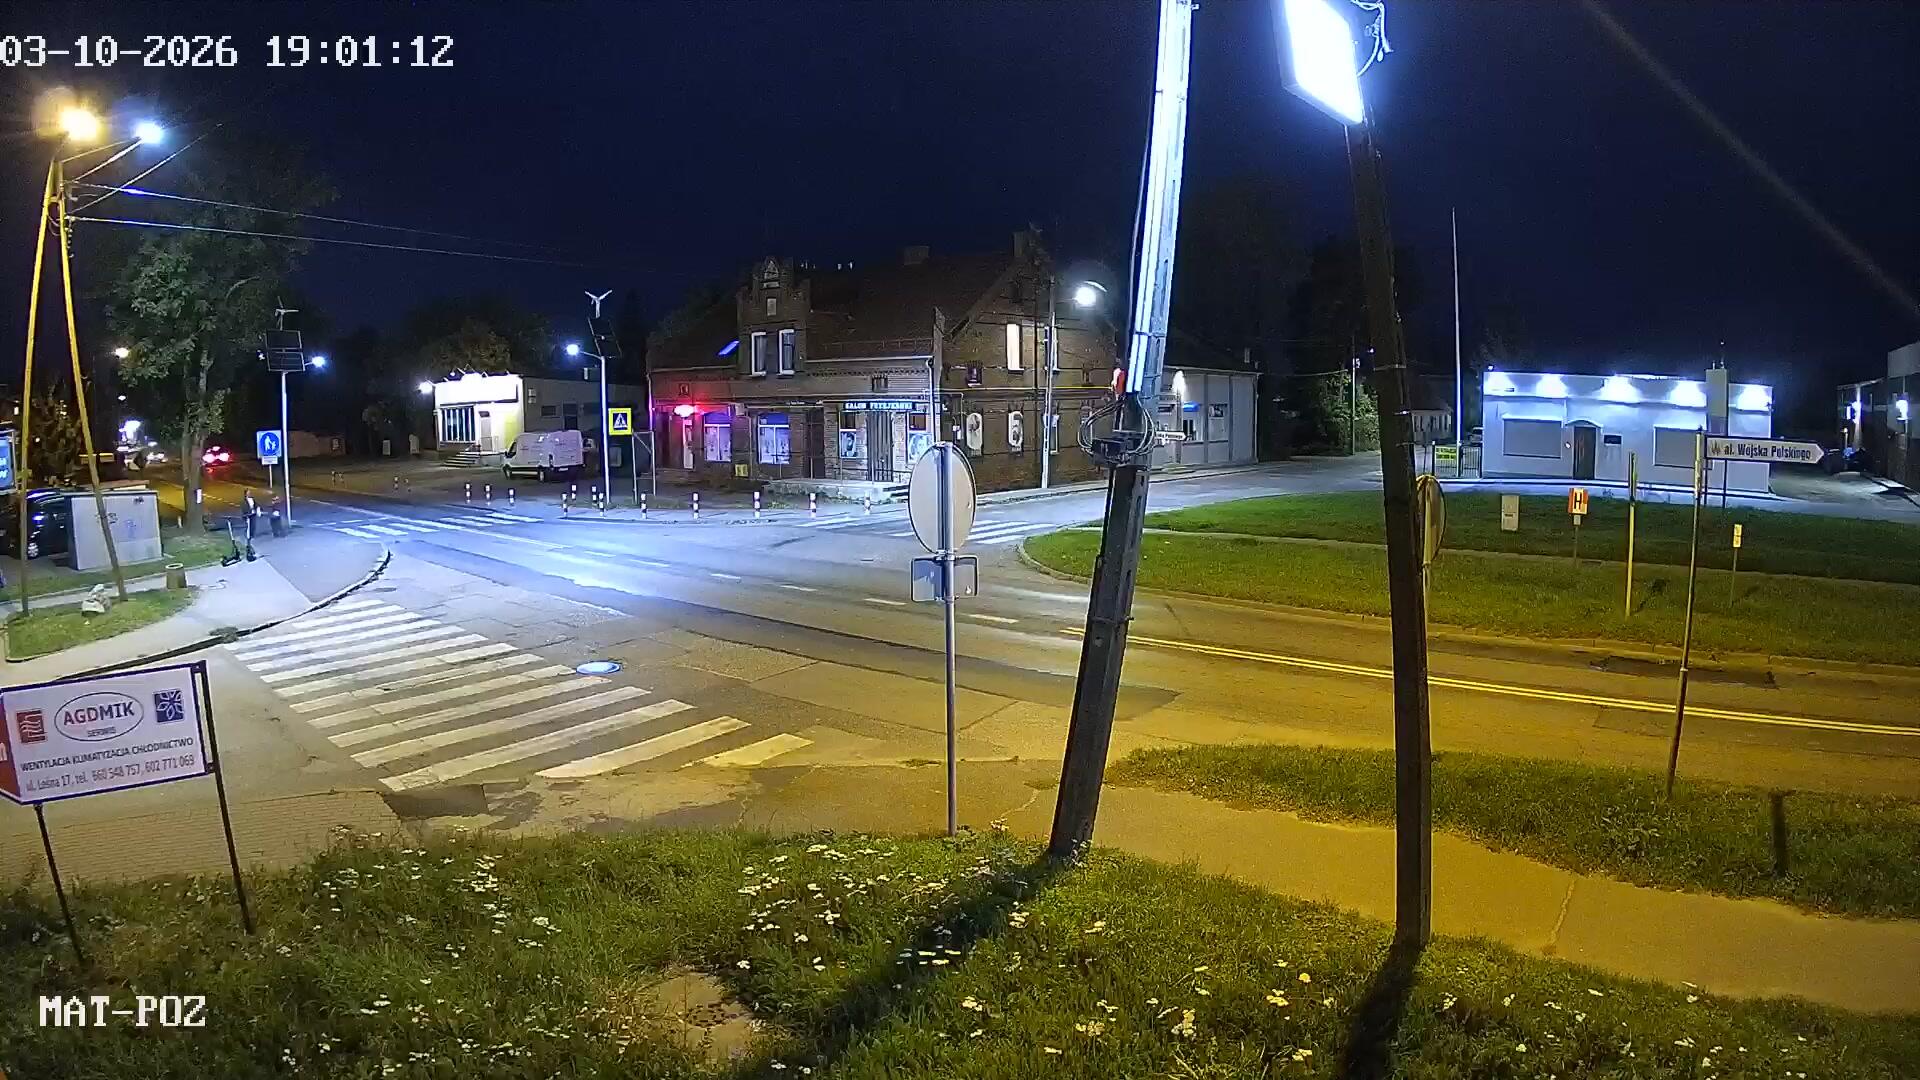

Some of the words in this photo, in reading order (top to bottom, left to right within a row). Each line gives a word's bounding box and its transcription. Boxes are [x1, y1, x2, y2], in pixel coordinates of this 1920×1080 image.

[1723, 443, 1735, 456] al.
[1737, 443, 1768, 458] Wojska
[1771, 445, 1811, 461] Polskiego
[63, 701, 135, 726] AGDMIK
[21, 756, 71, 772] WENTYLACJA
[72, 747, 130, 764] KLIMATYZACJA
[131, 737, 194, 755] CHŁODNICTWO
[145, 760, 160, 773] 602
[162, 757, 178, 770] 771
